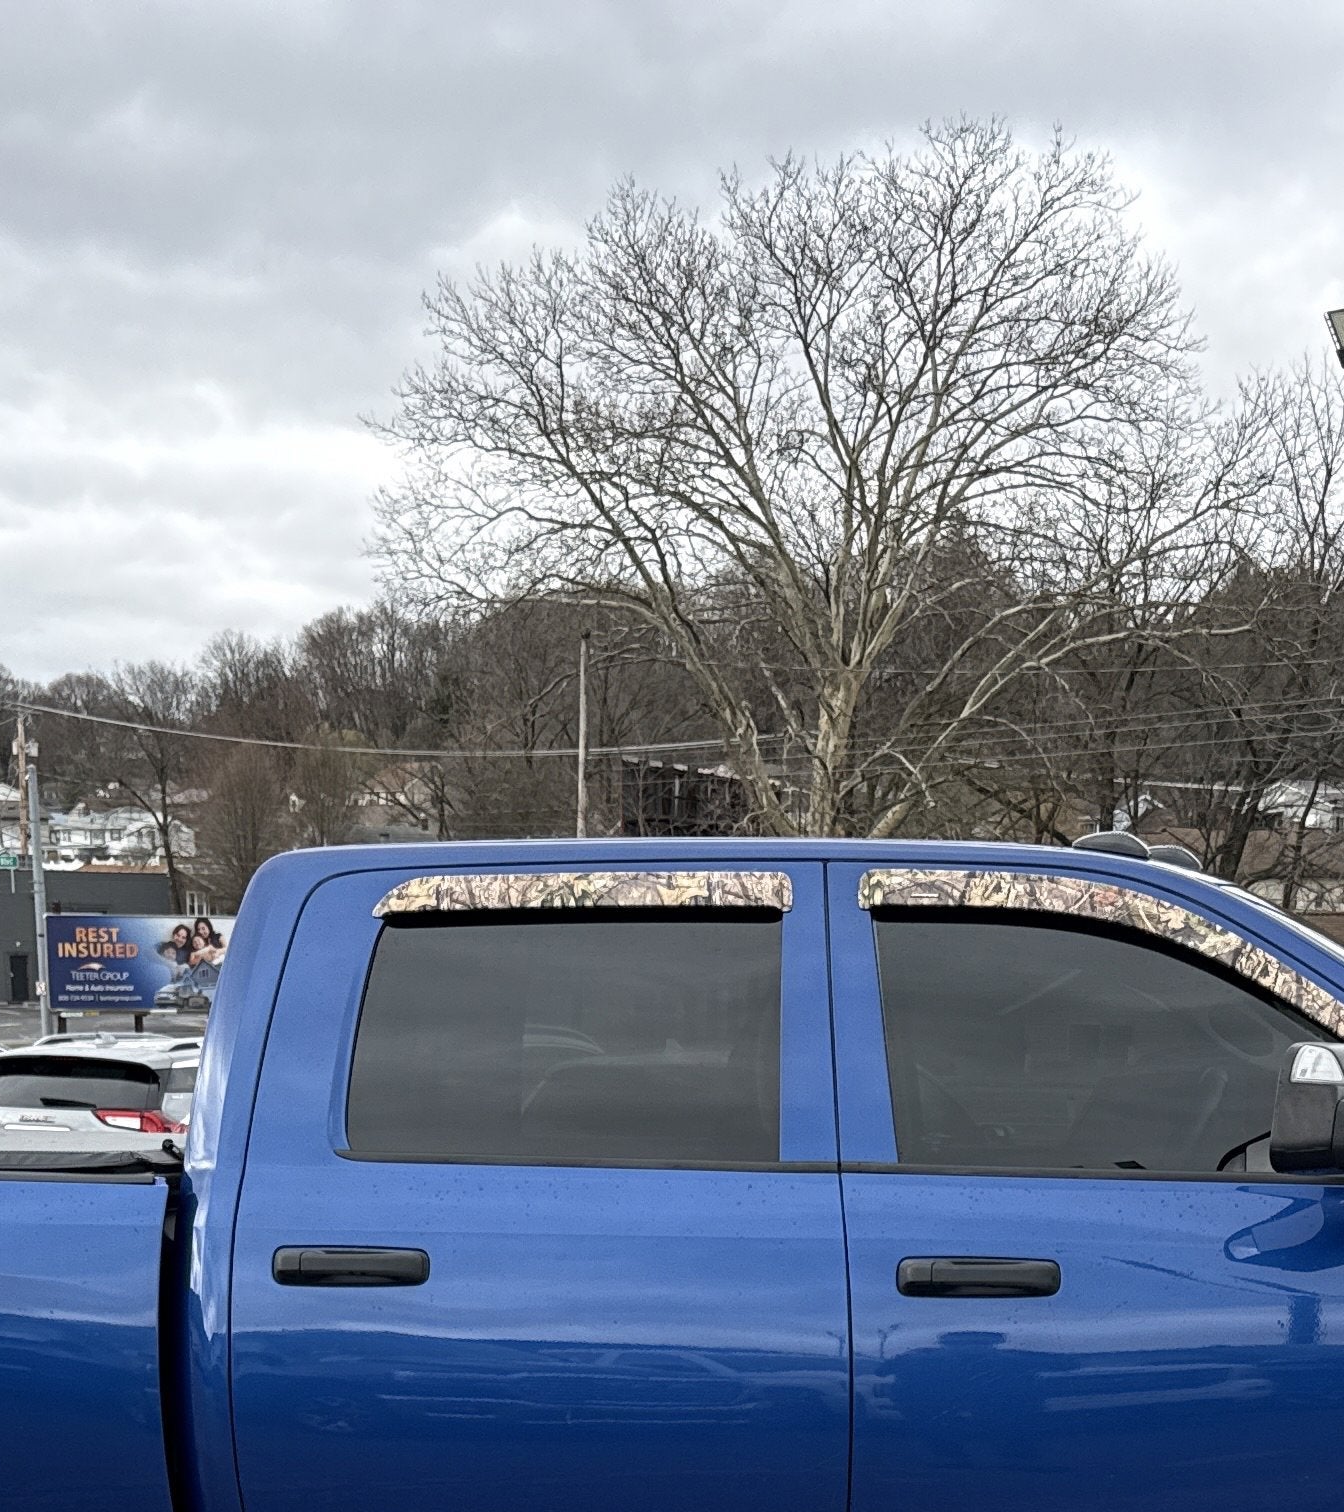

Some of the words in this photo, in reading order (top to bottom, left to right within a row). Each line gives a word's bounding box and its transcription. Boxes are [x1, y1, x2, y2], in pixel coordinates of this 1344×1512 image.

[75, 927, 120, 943] REST
[58, 942, 139, 959] INSURED
[70, 971, 99, 981] TEETER
[100, 971, 129, 982] GROUP
